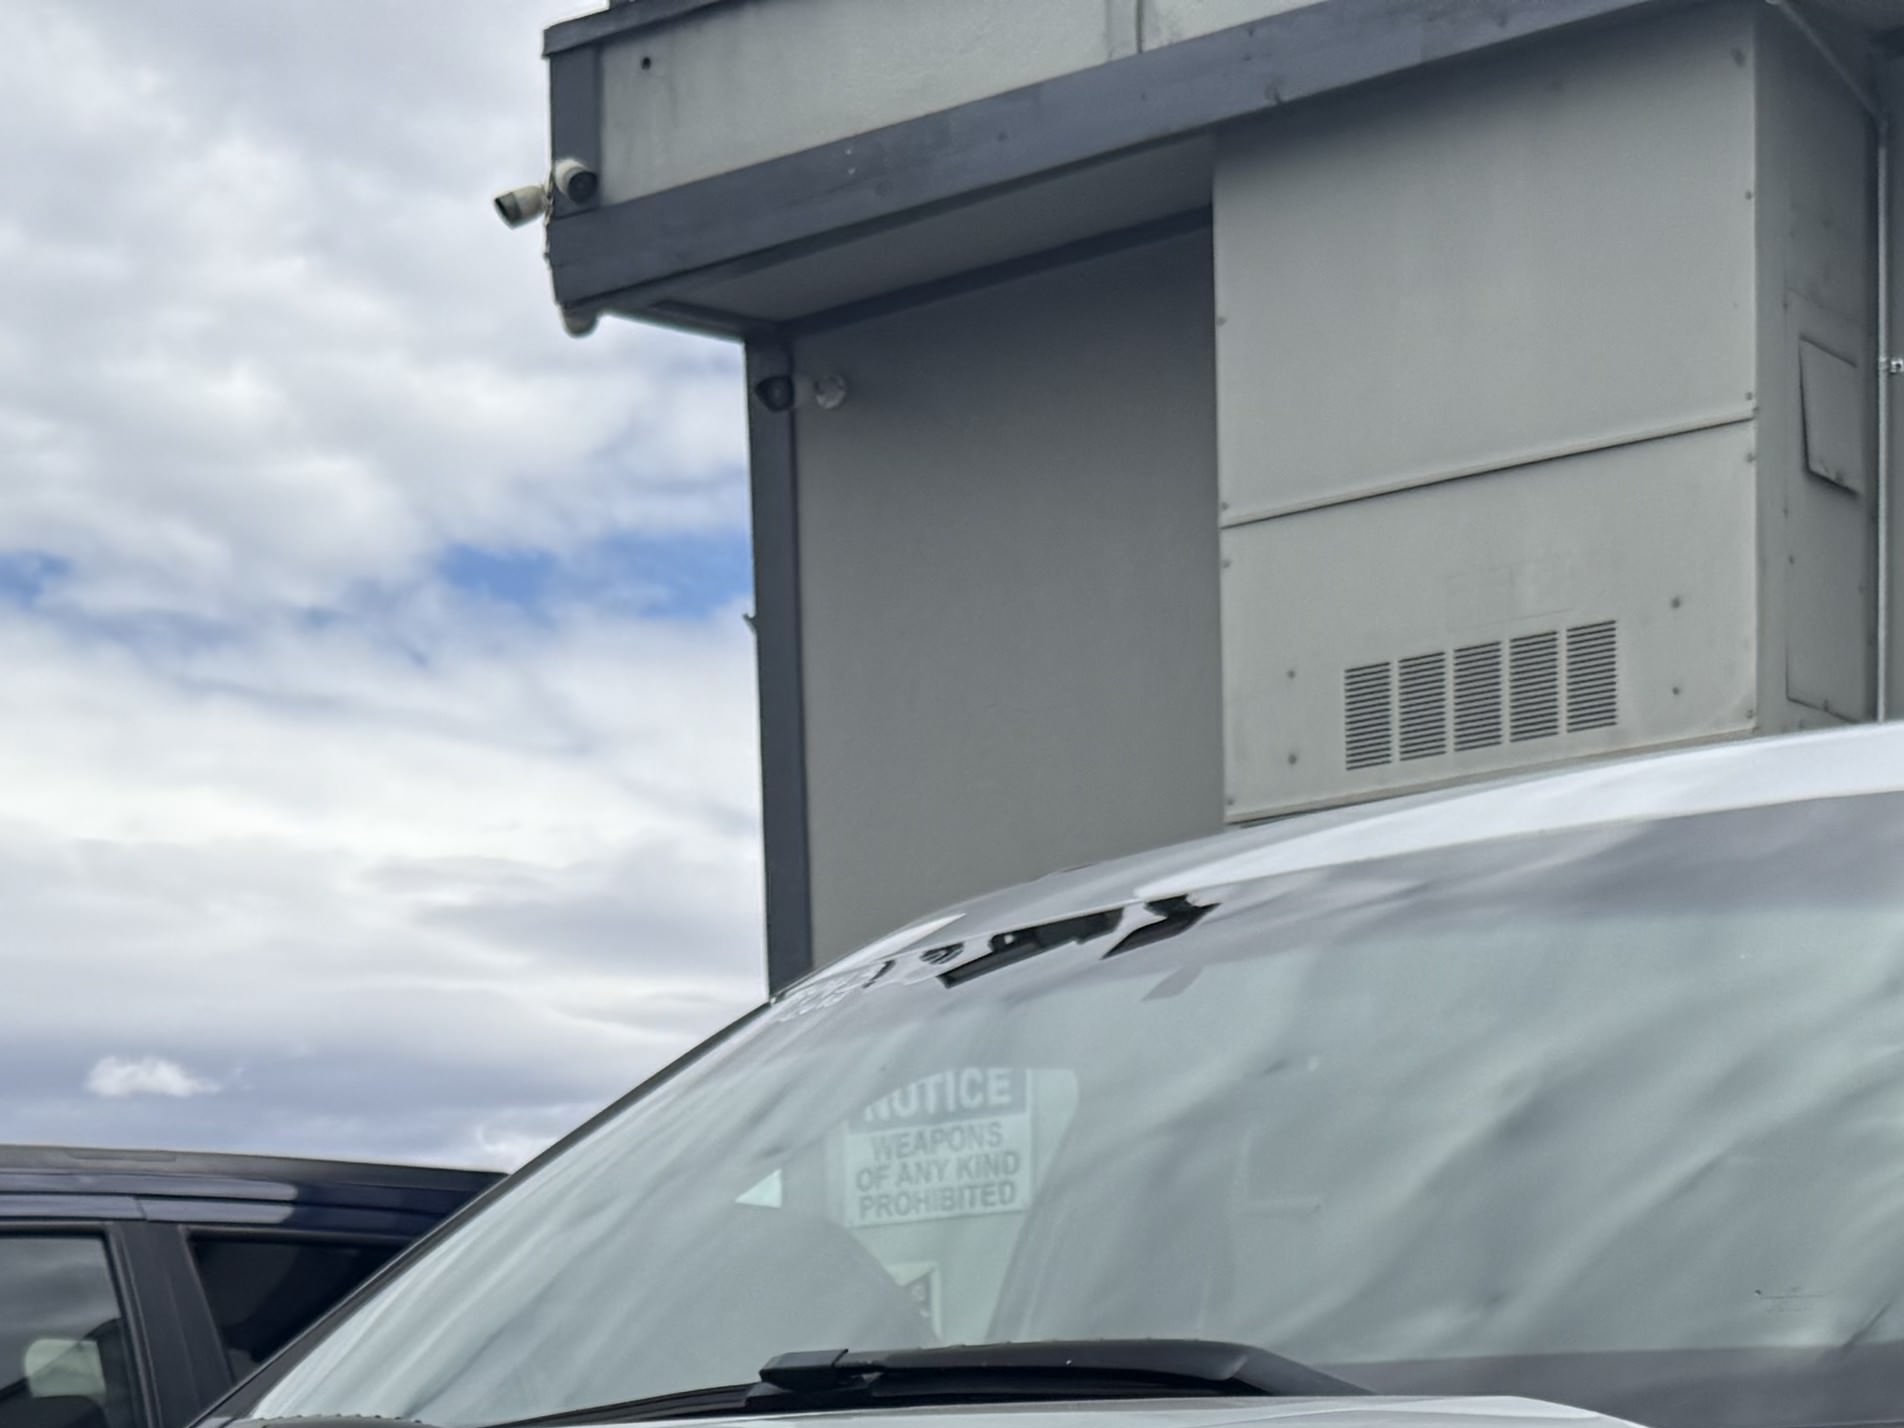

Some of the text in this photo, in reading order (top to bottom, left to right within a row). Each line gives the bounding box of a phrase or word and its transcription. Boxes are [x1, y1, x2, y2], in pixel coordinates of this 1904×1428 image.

[870, 1121, 1003, 1162] WEAPONS
[856, 1151, 1021, 1192] OF ANY KIND
[859, 1180, 1017, 1220] PROHIBITED
